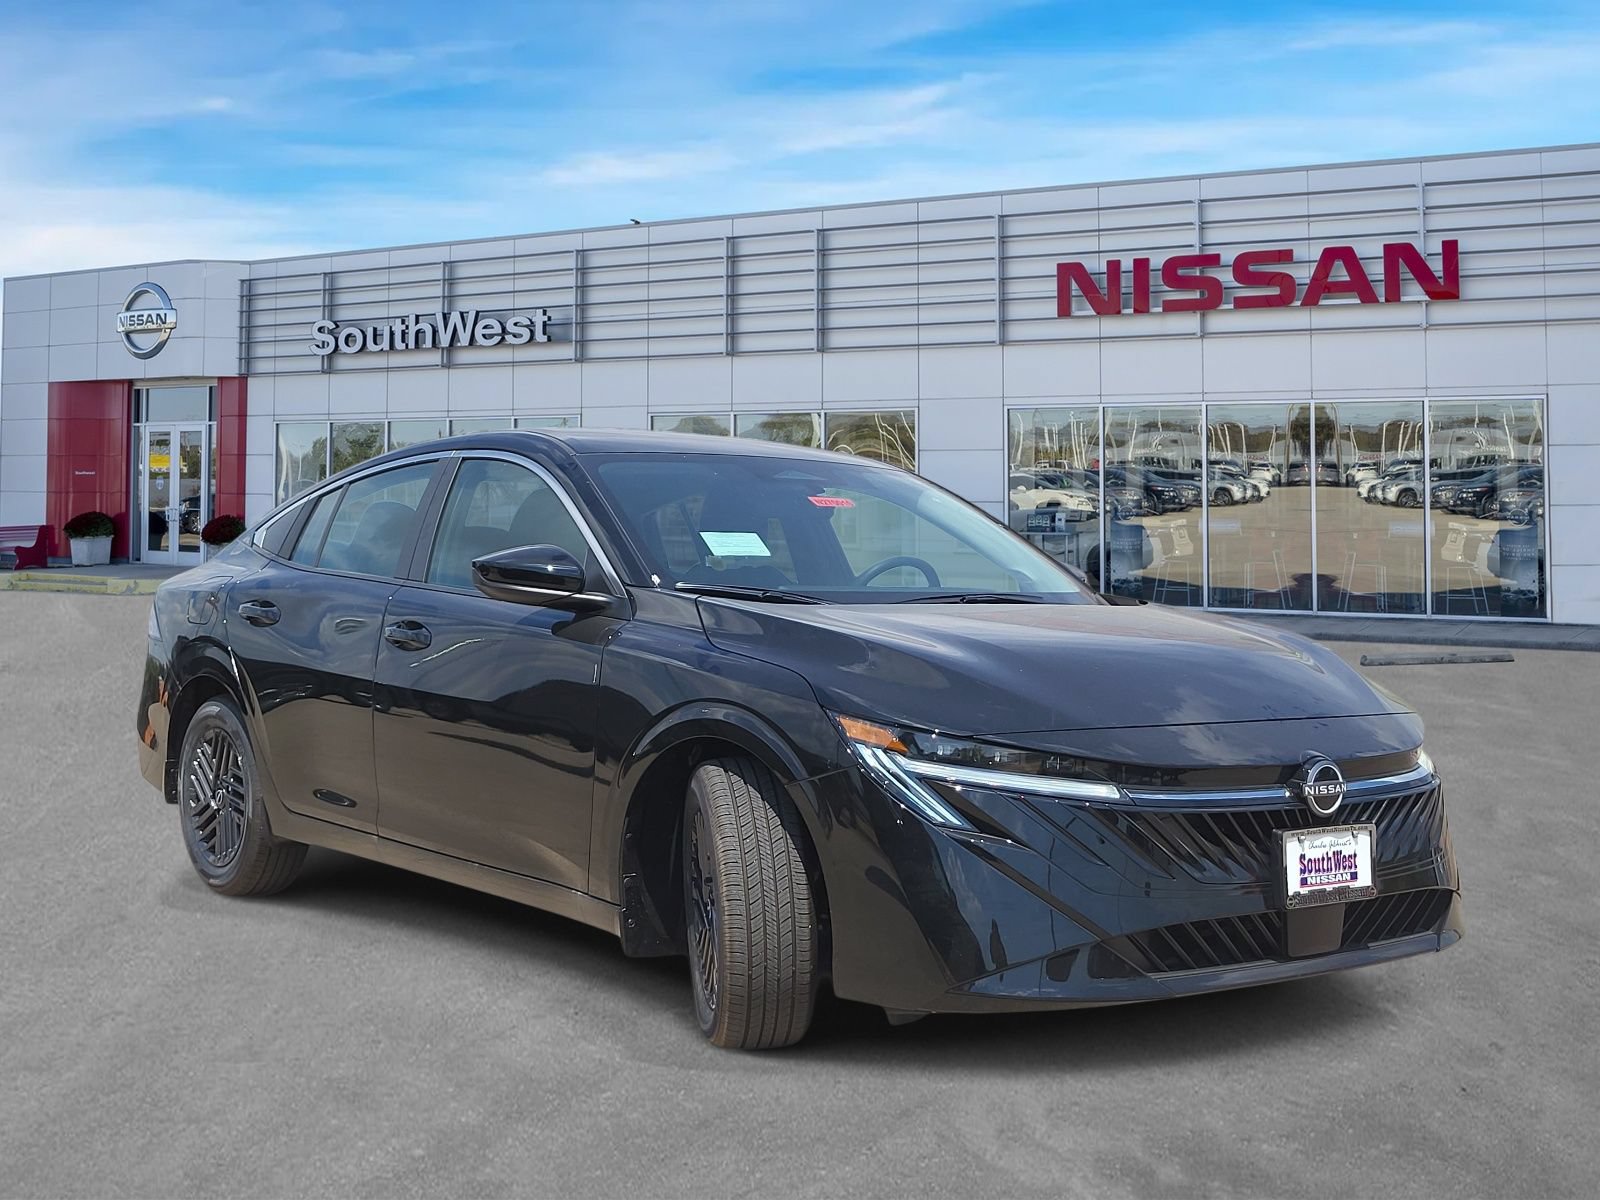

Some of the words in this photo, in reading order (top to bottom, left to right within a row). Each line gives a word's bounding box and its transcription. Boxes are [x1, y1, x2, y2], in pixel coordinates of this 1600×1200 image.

[1057, 240, 1460, 318] NISSAN
[119, 313, 167, 328] NISSAN
[309, 309, 551, 355] SouthWest
[1304, 784, 1347, 795] NISSAN
[1299, 850, 1358, 877] SouthWest
[1306, 872, 1351, 885] NISSAN
